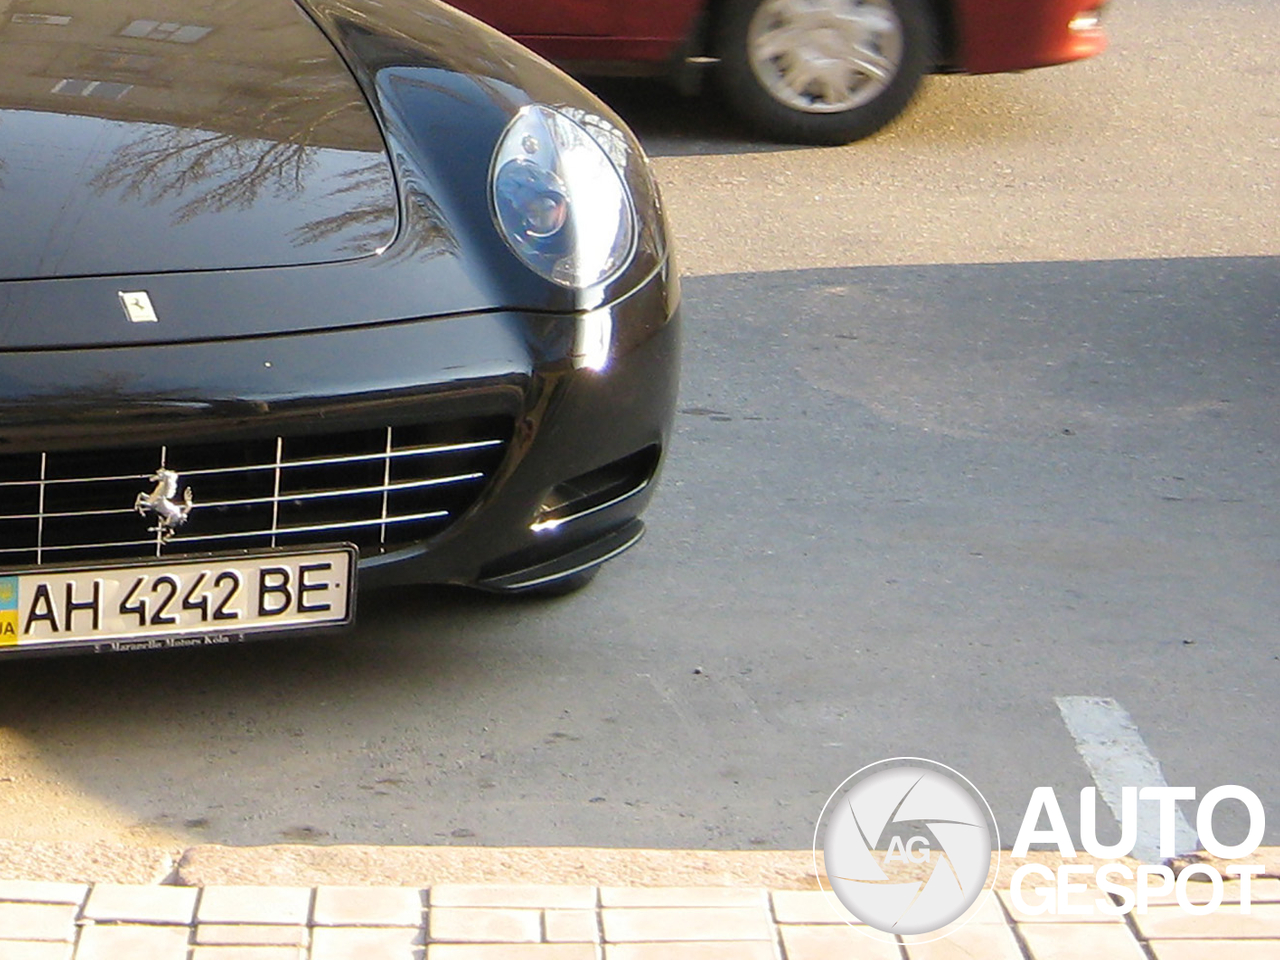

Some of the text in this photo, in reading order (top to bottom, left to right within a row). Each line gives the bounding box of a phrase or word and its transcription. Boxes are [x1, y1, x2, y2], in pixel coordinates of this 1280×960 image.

[24, 562, 333, 635] AH 4242 BE
